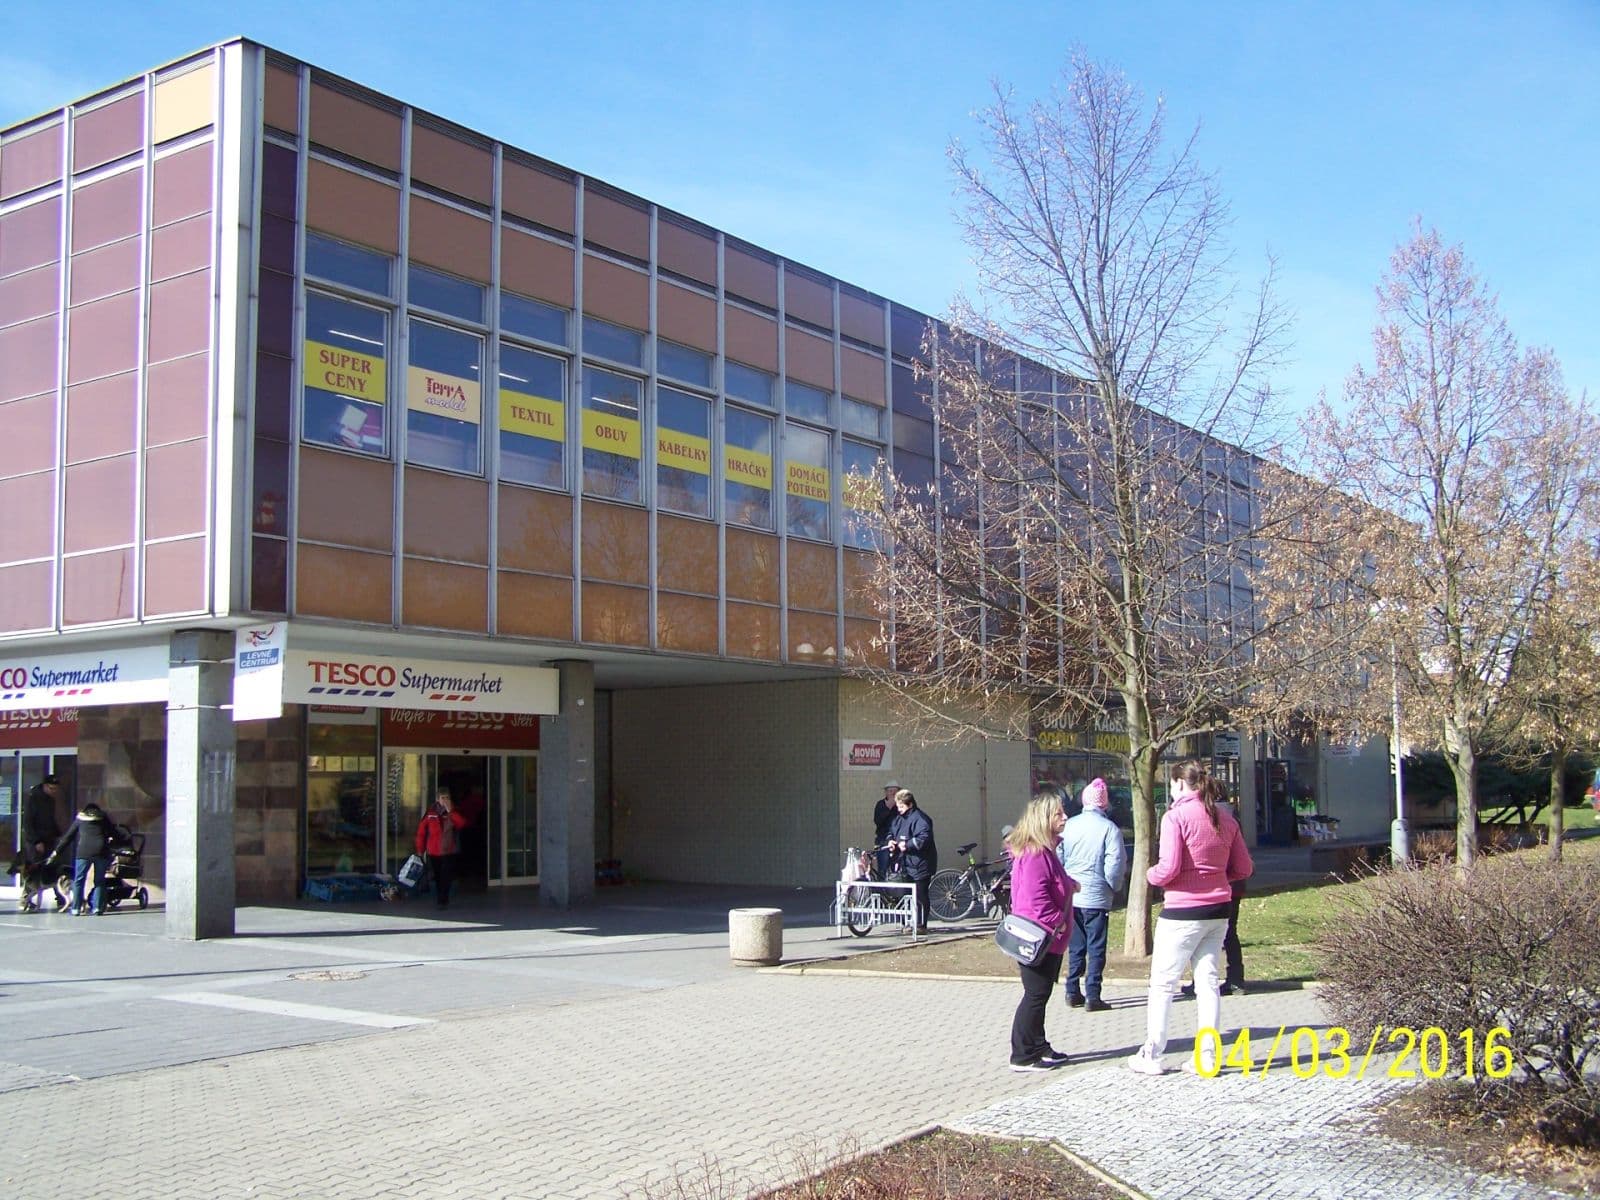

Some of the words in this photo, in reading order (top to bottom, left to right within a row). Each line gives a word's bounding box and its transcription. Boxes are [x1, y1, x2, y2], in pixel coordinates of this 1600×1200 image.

[319, 349, 371, 375] SUPER
[324, 371, 367, 393] CENY
[510, 405, 555, 426] TEXTIL
[595, 425, 629, 443] OBUV
[658, 440, 708, 462] KABELKY
[728, 458, 768, 478] HRAČKY
[789, 466, 825, 485] DOMÁCÍ
[786, 480, 828, 499] POTŘEBY
[240, 657, 278, 668] CENTRUM
[247, 650, 272, 660] LEVNÉ
[30, 661, 119, 690] Supermarket
[308, 661, 396, 687] TESCO
[400, 666, 502, 694] Supermarket
